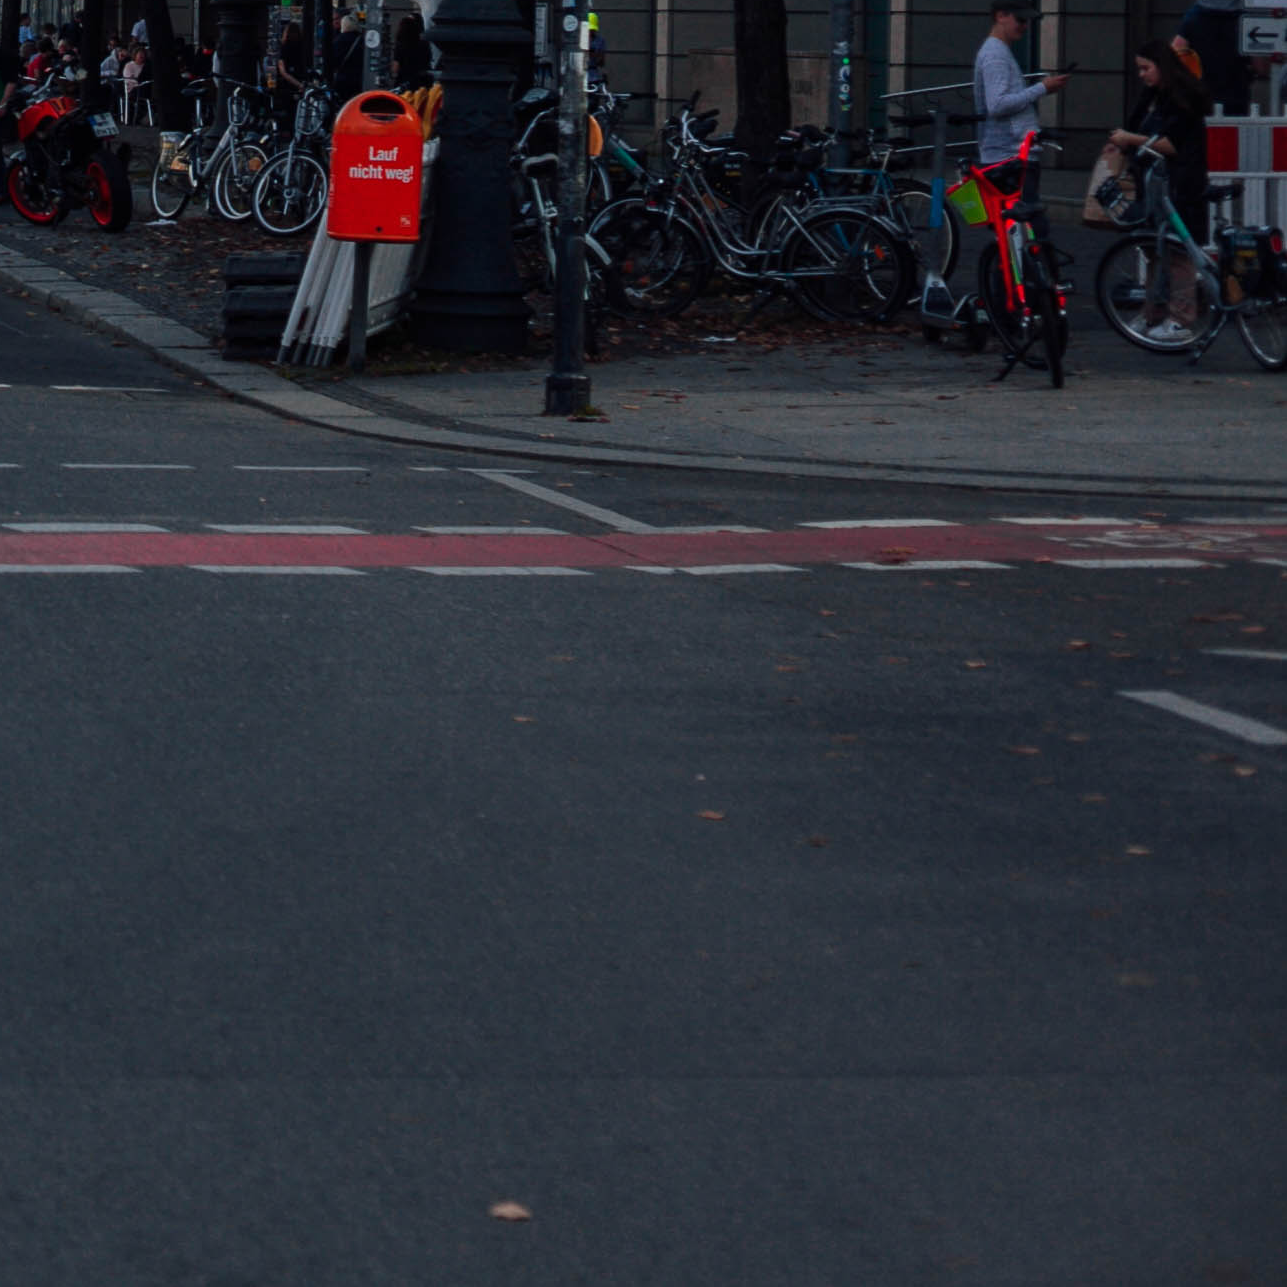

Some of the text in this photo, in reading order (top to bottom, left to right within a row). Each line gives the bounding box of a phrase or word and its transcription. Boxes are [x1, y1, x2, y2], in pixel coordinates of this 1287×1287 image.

[369, 145, 399, 162] Lauf
[349, 163, 414, 183] nicht weg!
